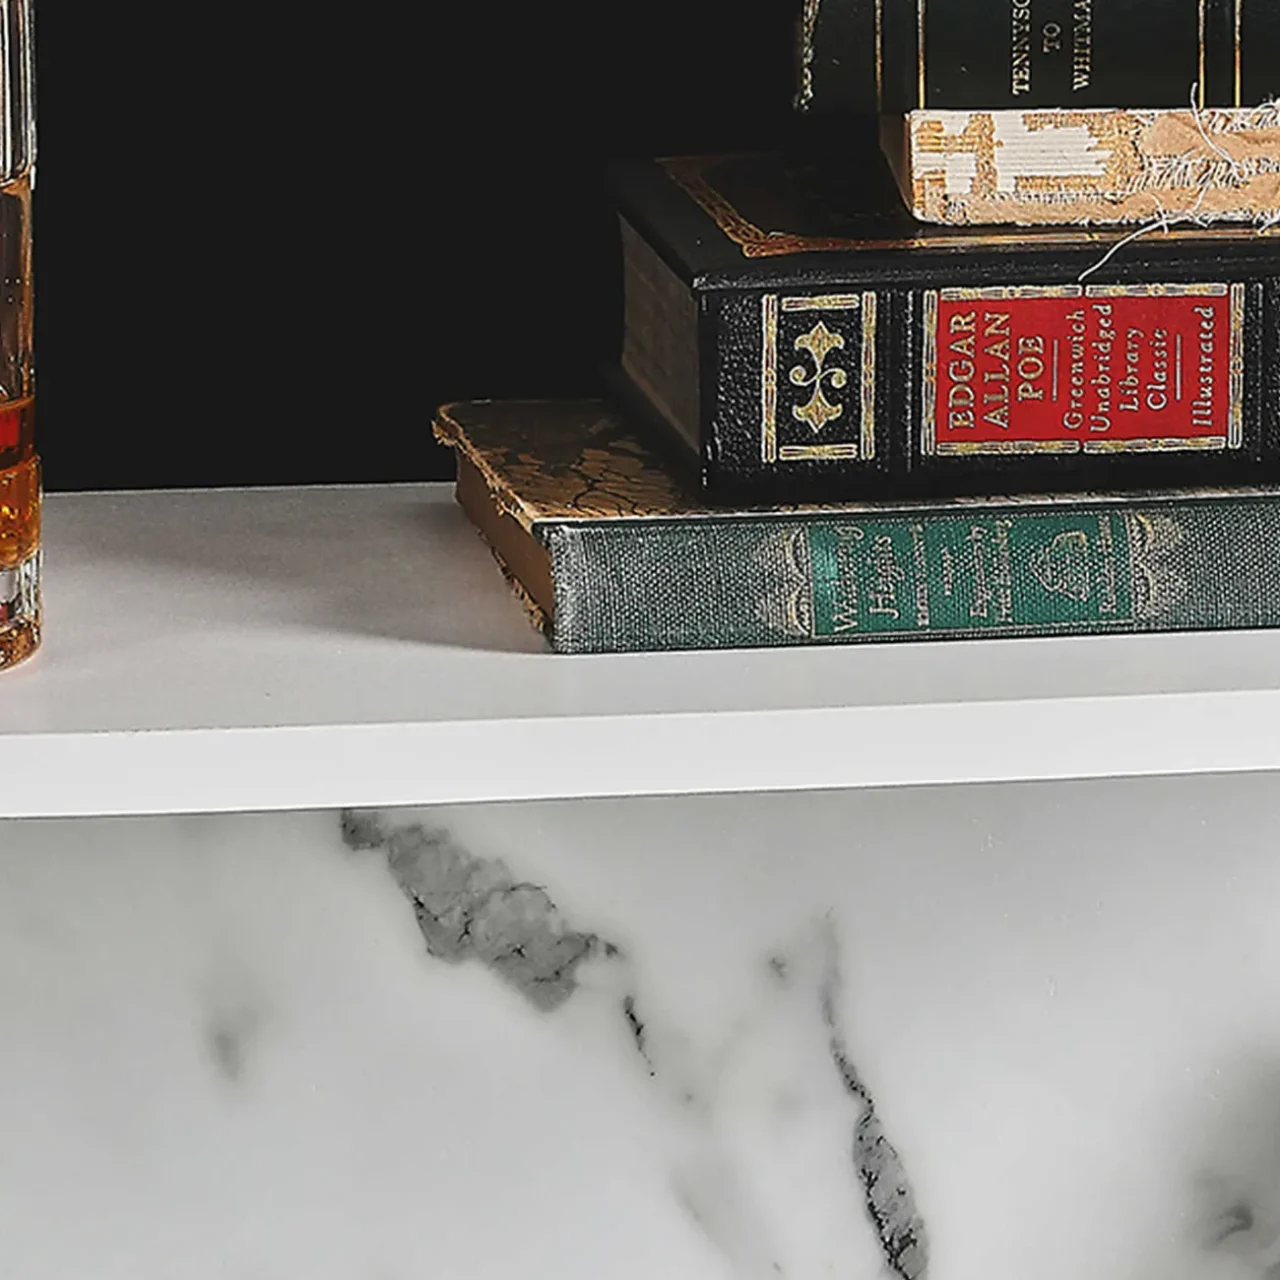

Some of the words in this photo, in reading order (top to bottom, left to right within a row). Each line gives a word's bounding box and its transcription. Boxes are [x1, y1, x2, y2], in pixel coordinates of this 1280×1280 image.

[1043, 22, 1060, 53] TO
[949, 311, 976, 430] EDGAR
[983, 312, 1010, 429] ALLAN
[1017, 335, 1044, 402] POE
[1063, 309, 1086, 430] Greenwich
[1090, 304, 1116, 432] Unabridged
[1119, 327, 1144, 412] Library
[1146, 328, 1167, 411] Classic
[1192, 306, 1214, 426] Illustrated
